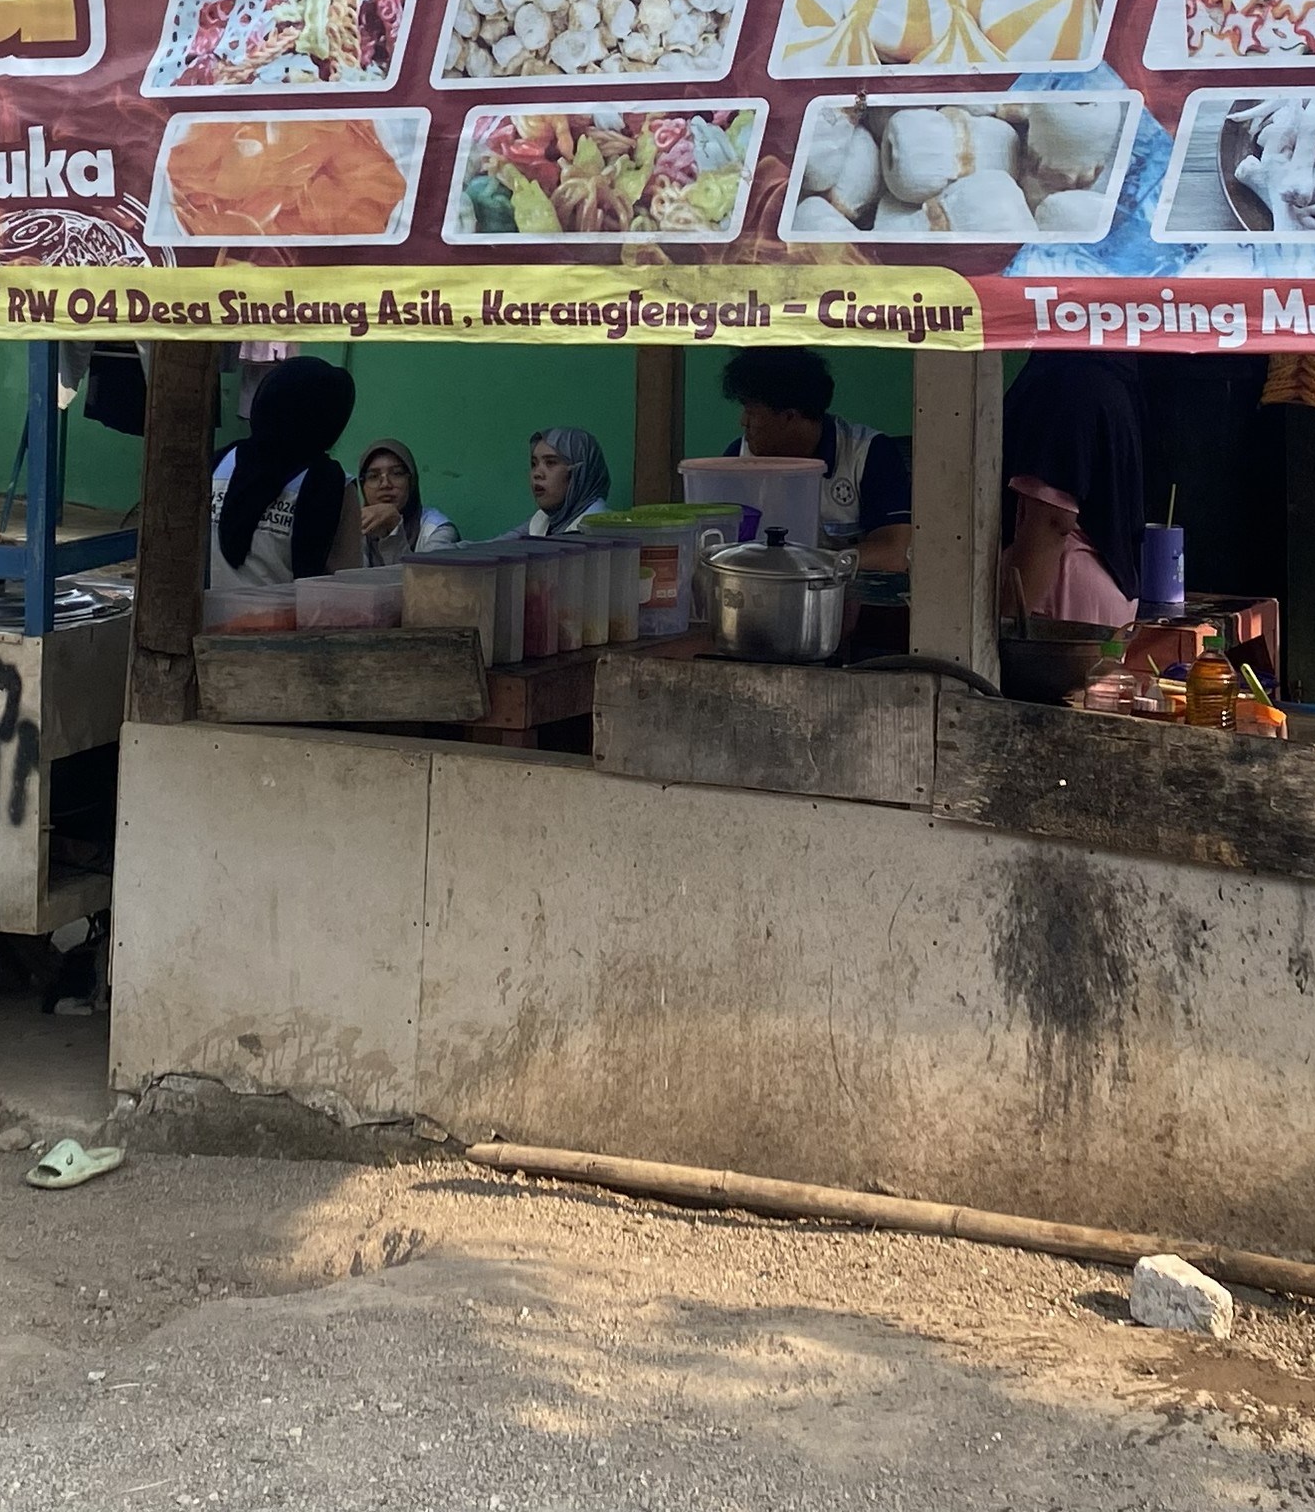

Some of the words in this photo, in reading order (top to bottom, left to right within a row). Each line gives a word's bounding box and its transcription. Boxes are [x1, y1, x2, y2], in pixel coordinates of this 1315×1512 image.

[7, 287, 59, 323] RW
[127, 289, 212, 325] Desa
[219, 289, 369, 338] Sindang
[481, 288, 772, 341] Karangtengah
[816, 290, 975, 344] Cianjur
[1024, 285, 1247, 349] Topping
